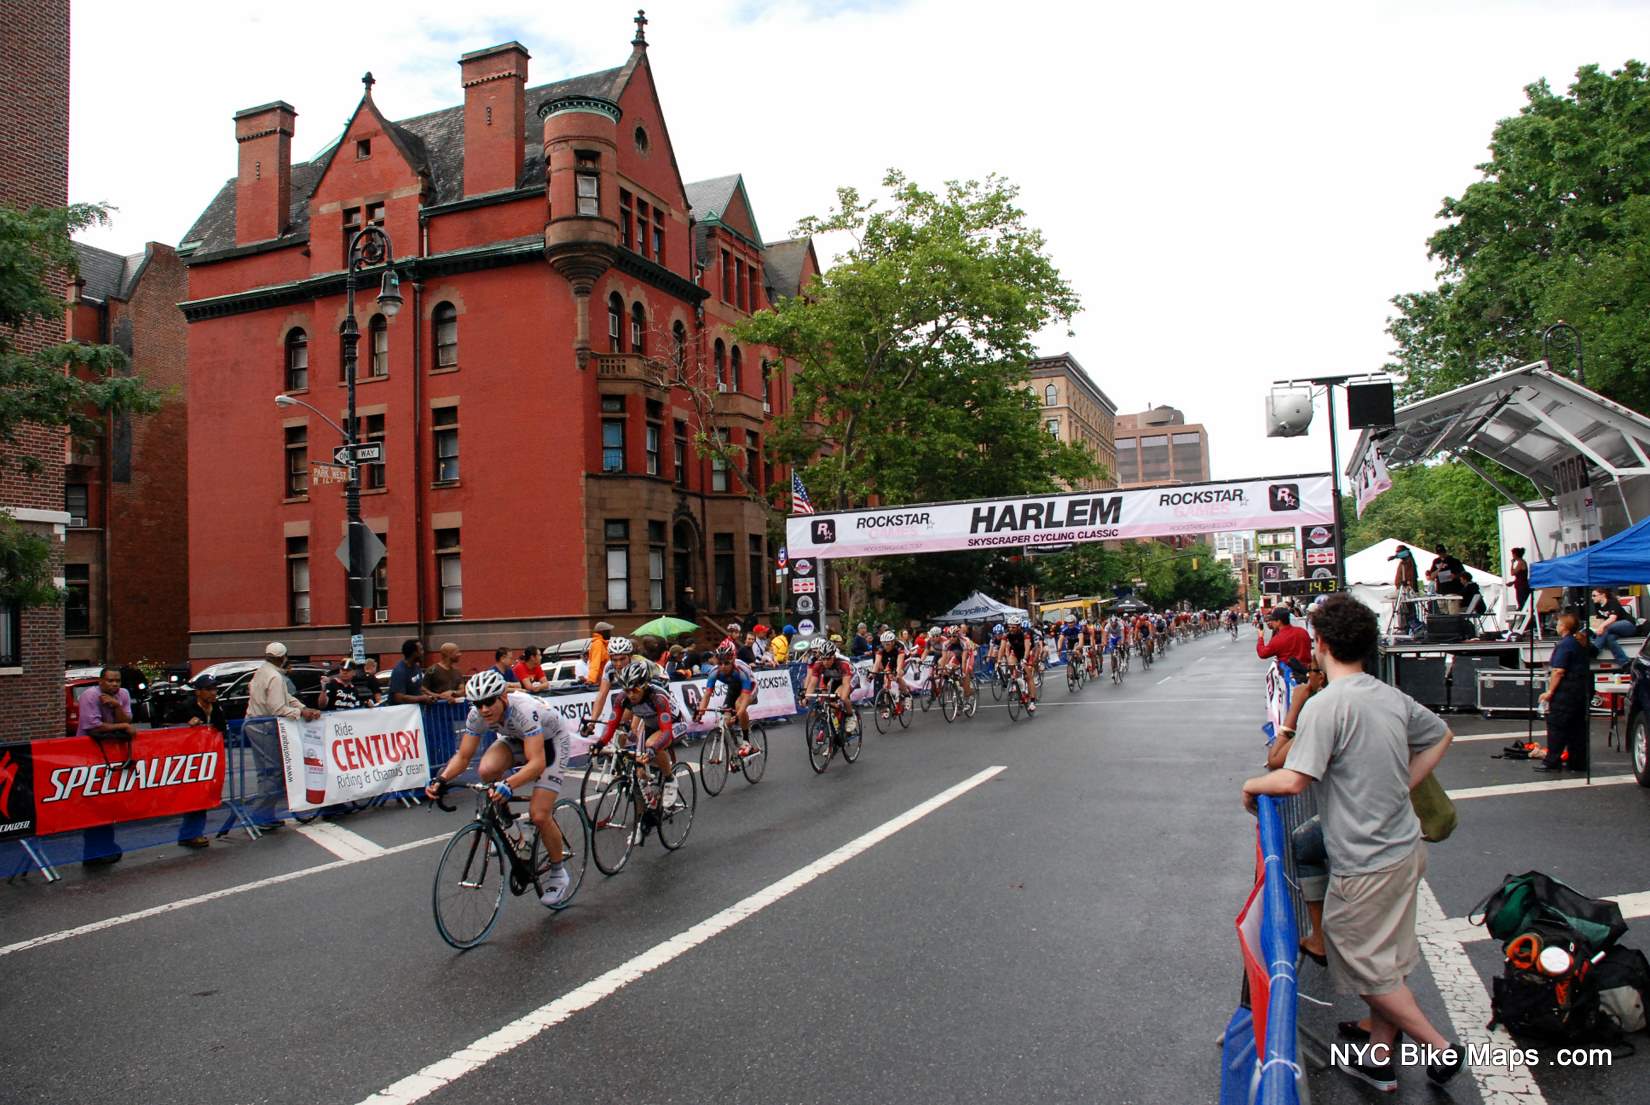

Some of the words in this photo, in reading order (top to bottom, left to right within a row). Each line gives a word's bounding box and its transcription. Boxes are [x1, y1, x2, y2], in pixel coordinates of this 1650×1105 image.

[361, 449, 375, 458] WAY
[313, 467, 330, 479] PARK
[1159, 488, 1244, 507] ROCKSTAR
[856, 513, 930, 529] ROCKSTAR
[970, 496, 1123, 534] HARLEM
[968, 535, 1031, 547] SKYSCRAPER
[1033, 531, 1075, 543] CYCLING
[1077, 529, 1119, 540] CLASSIC
[554, 701, 594, 720] KSTA
[334, 722, 353, 736] Ride
[332, 728, 420, 772] CENTURY
[43, 752, 218, 802] SPECIALIZED
[337, 774, 363, 789] Riding
[364, 771, 371, 784] &
